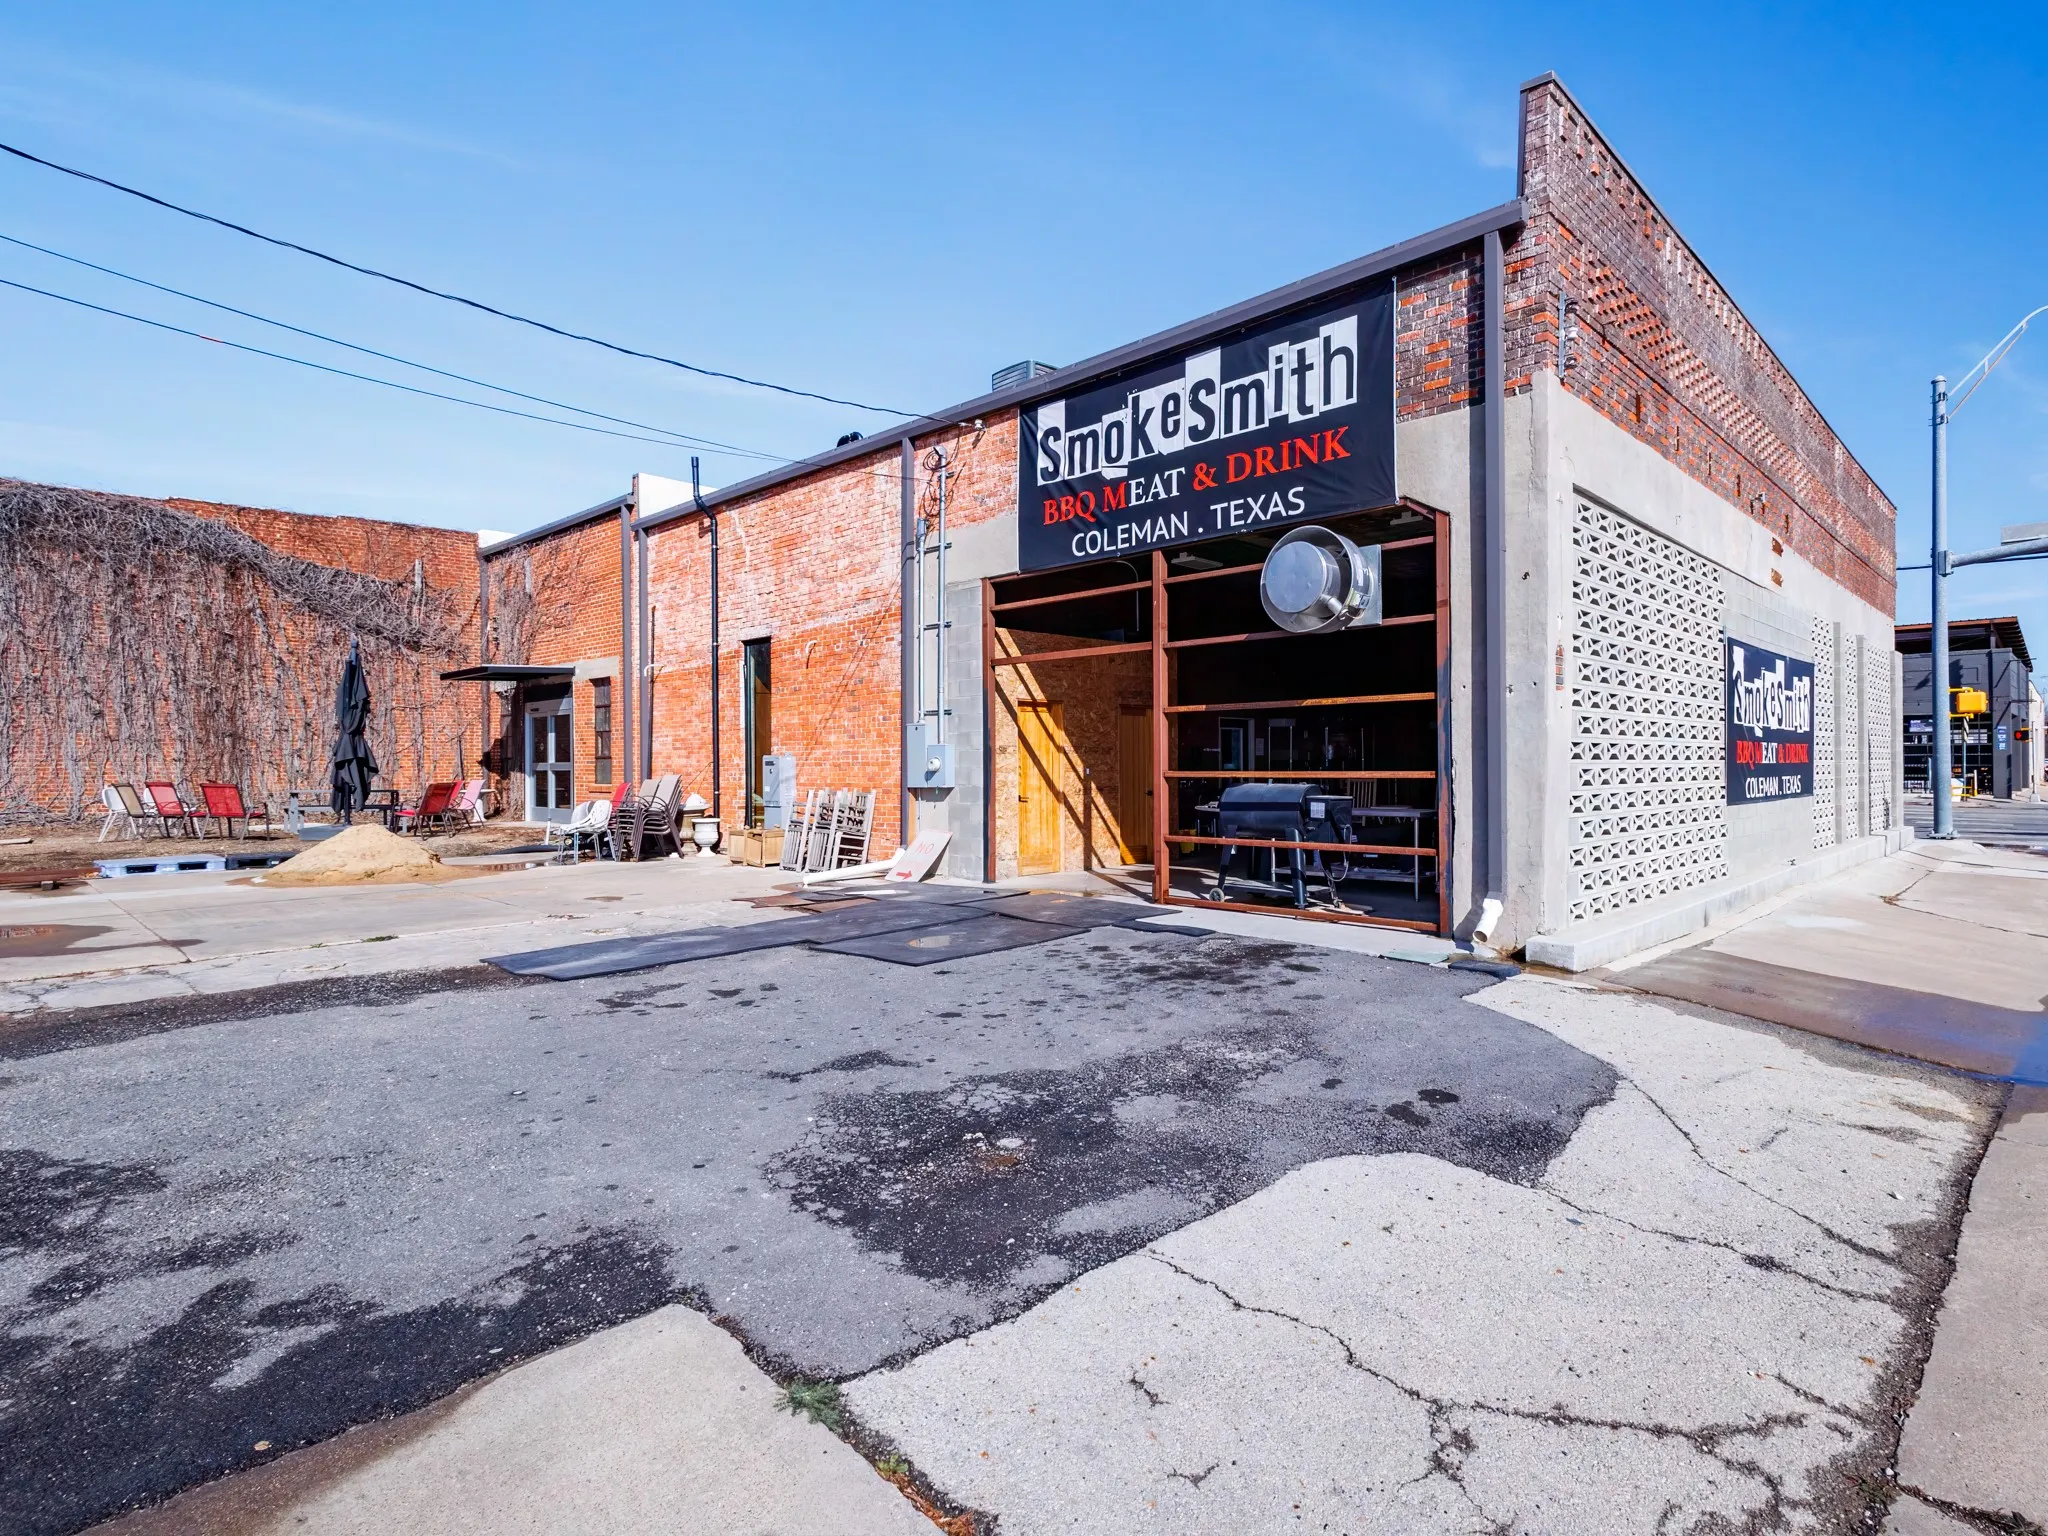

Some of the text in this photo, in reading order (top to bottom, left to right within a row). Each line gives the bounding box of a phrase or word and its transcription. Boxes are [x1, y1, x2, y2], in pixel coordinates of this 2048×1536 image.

[1038, 324, 1356, 484] SmokeSmith
[1043, 426, 1351, 525] BBQ MEAT & DRINK
[1071, 511, 1188, 557] COLEMAN
[1209, 486, 1305, 530] TEXAS
[1733, 660, 1810, 733] SmokeSmith
[1736, 740, 1809, 769] BBQ MEAT & DRINK
[1745, 776, 1779, 798] COLEMAN
[1782, 775, 1801, 795] TEXAS
